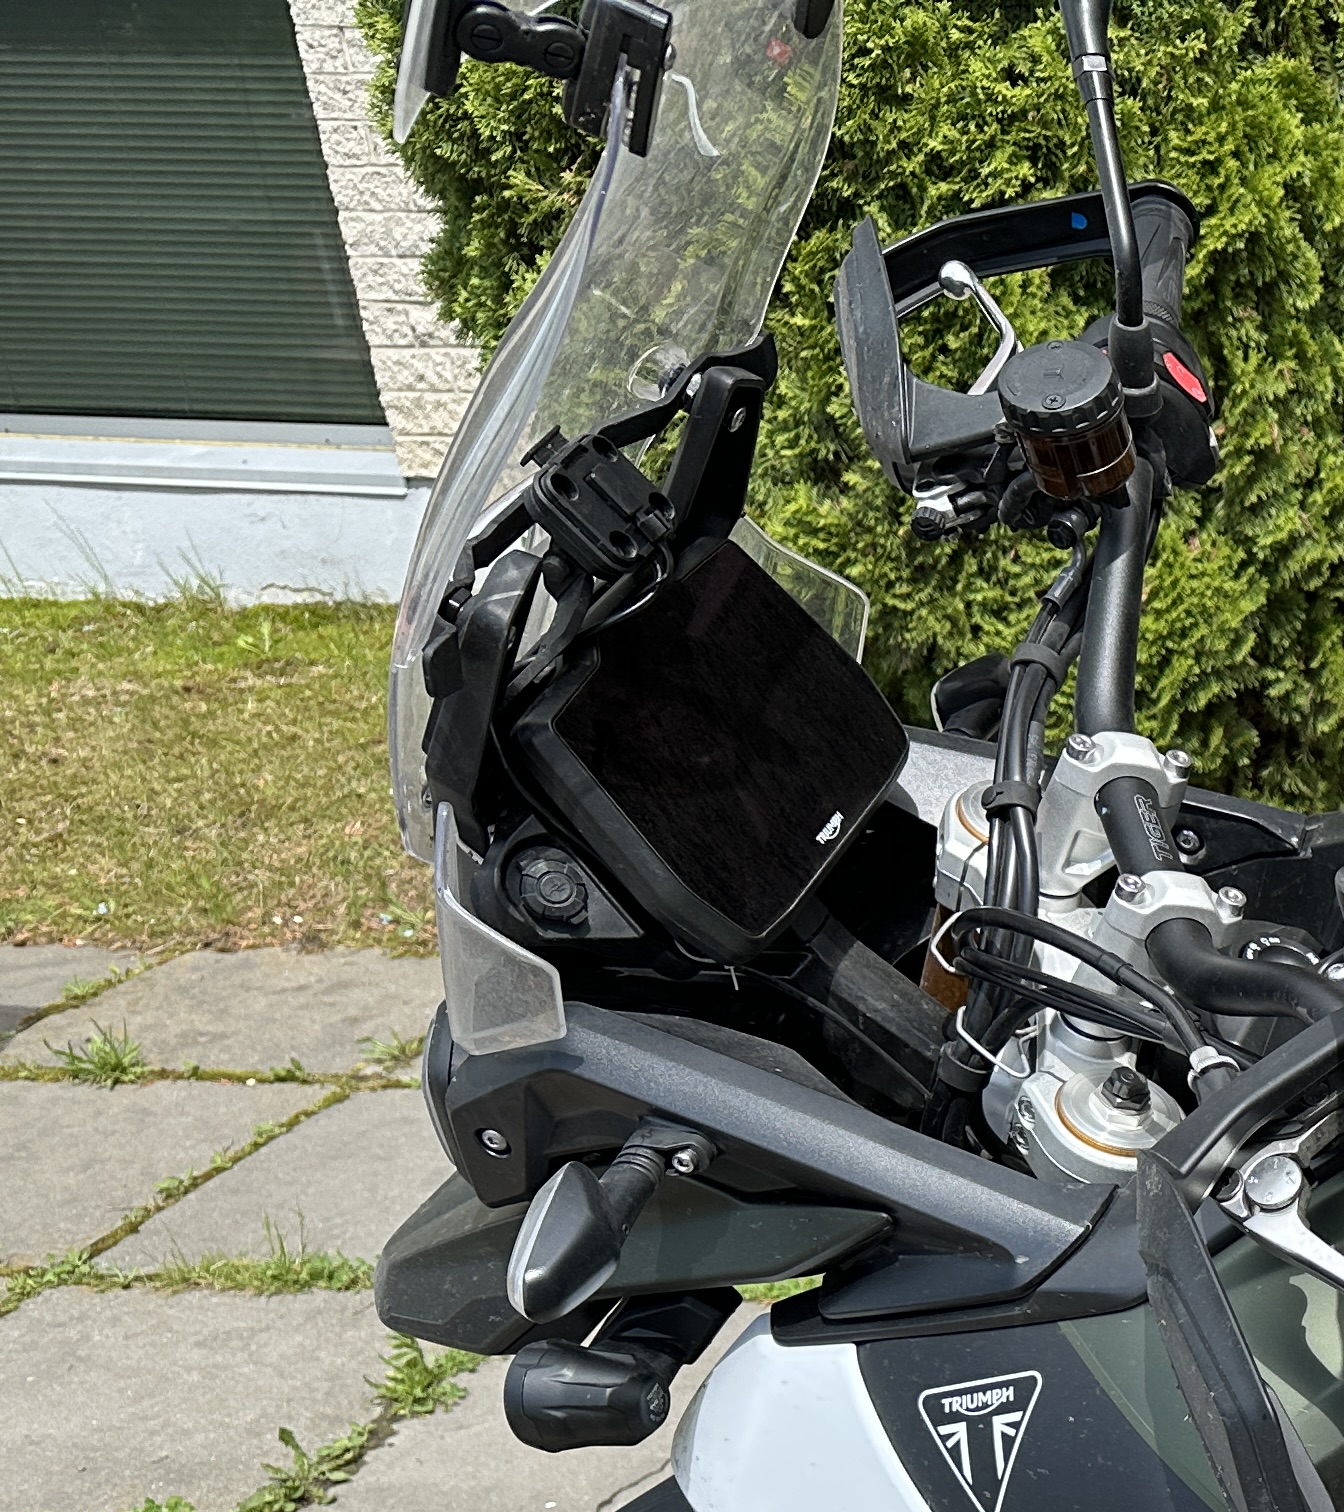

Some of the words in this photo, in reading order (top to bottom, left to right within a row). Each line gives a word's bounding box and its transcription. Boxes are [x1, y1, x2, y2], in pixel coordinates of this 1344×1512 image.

[815, 810, 845, 845] TRIUMPH
[1133, 794, 1174, 862] TIGER
[941, 1385, 1015, 1416] TRIUMPH
